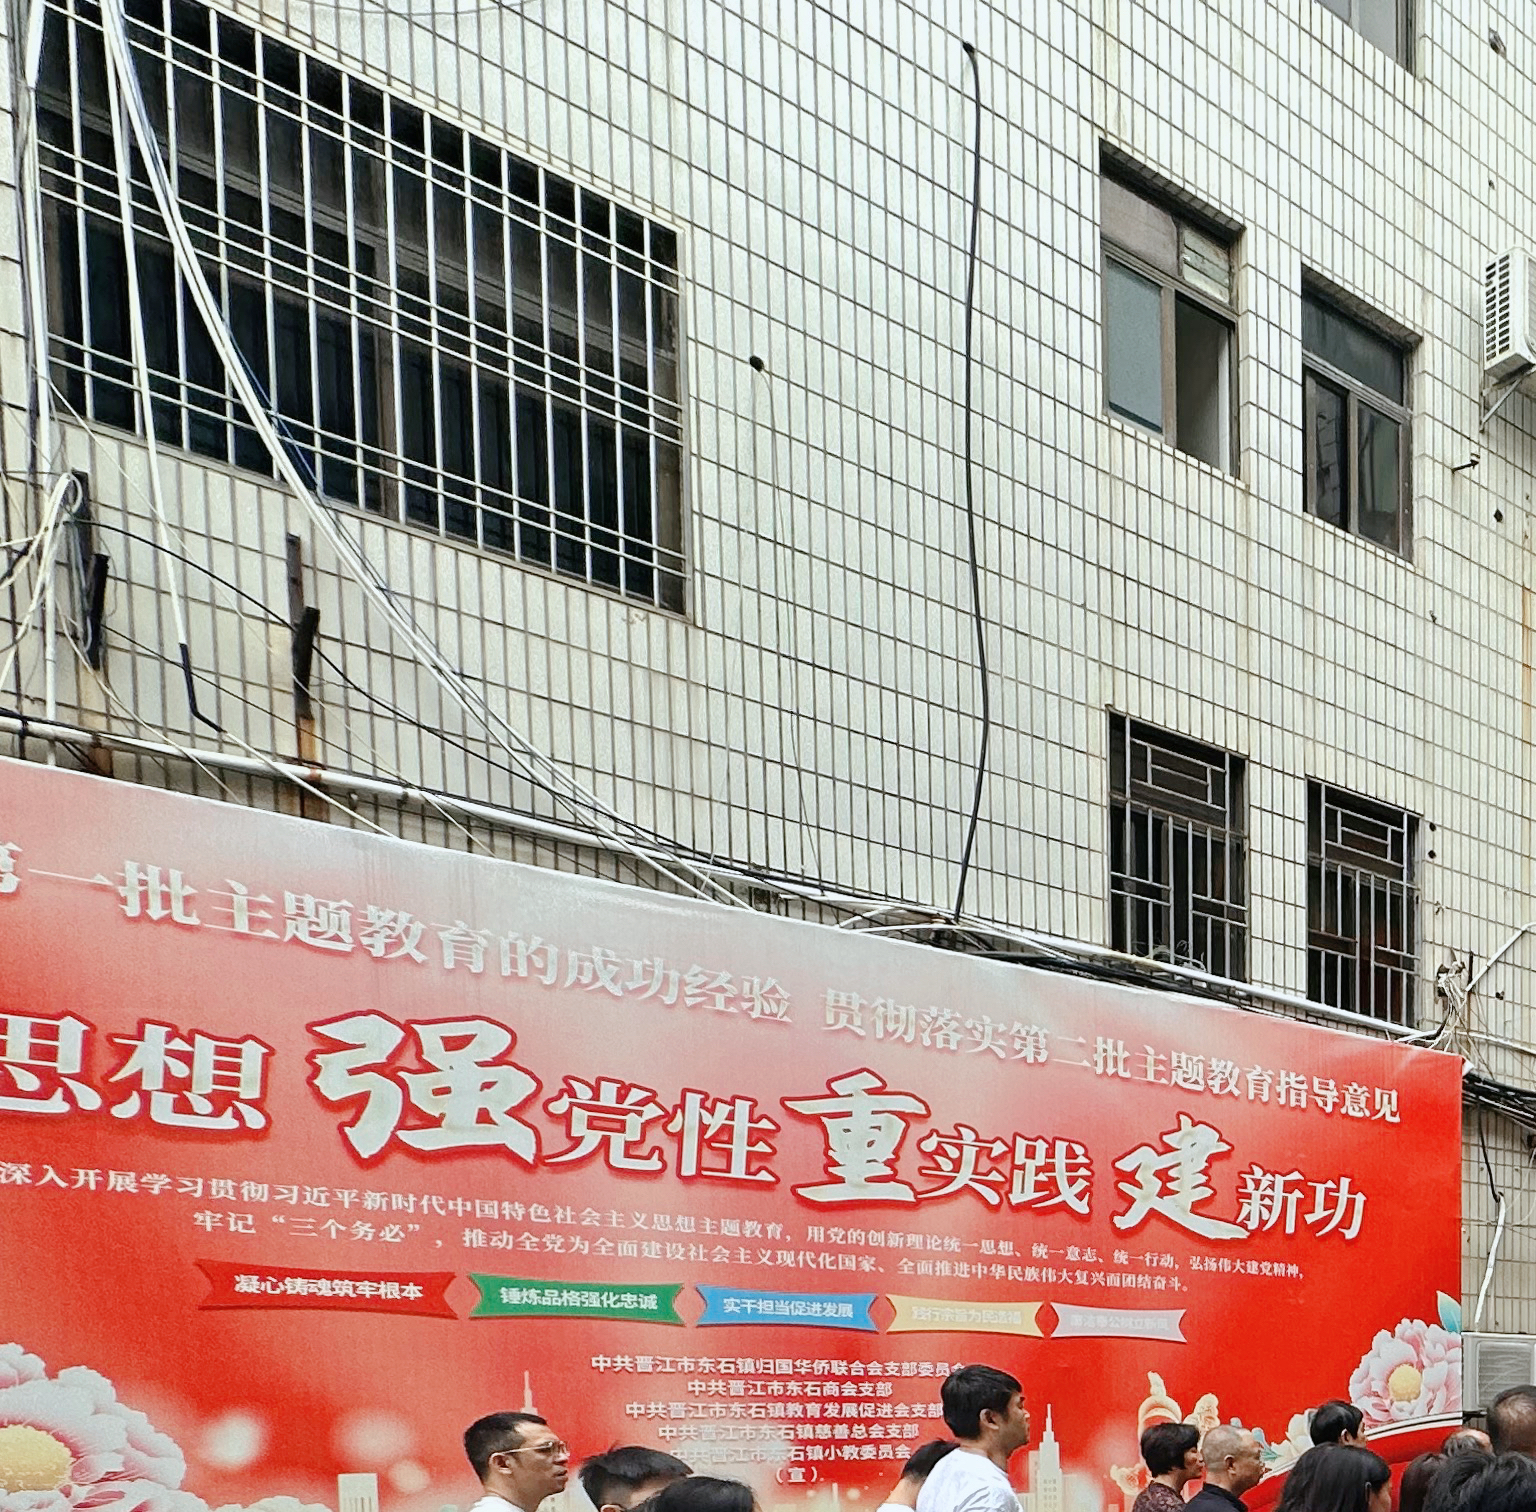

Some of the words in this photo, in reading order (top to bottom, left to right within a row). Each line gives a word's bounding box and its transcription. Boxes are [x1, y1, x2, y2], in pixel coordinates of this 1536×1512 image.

[0, 841, 792, 1024] 一批主题教育的成功经验
[821, 985, 1401, 1123] 贯彻落实第二批主题教育指导意见
[234, 1274, 424, 1302] 凝心铸魂筑牢根本
[499, 1285, 658, 1311] 锤炼品格强化忠诚
[723, 1296, 853, 1319] 实干担当促进发展
[687, 1379, 893, 1398] 中共晋江市东石商会支部
[625, 1401, 942, 1420] 中共晋江市东石镇教育发展促进会支部
[658, 1422, 920, 1441] 中共晋江市东石镇慈善总会支部
